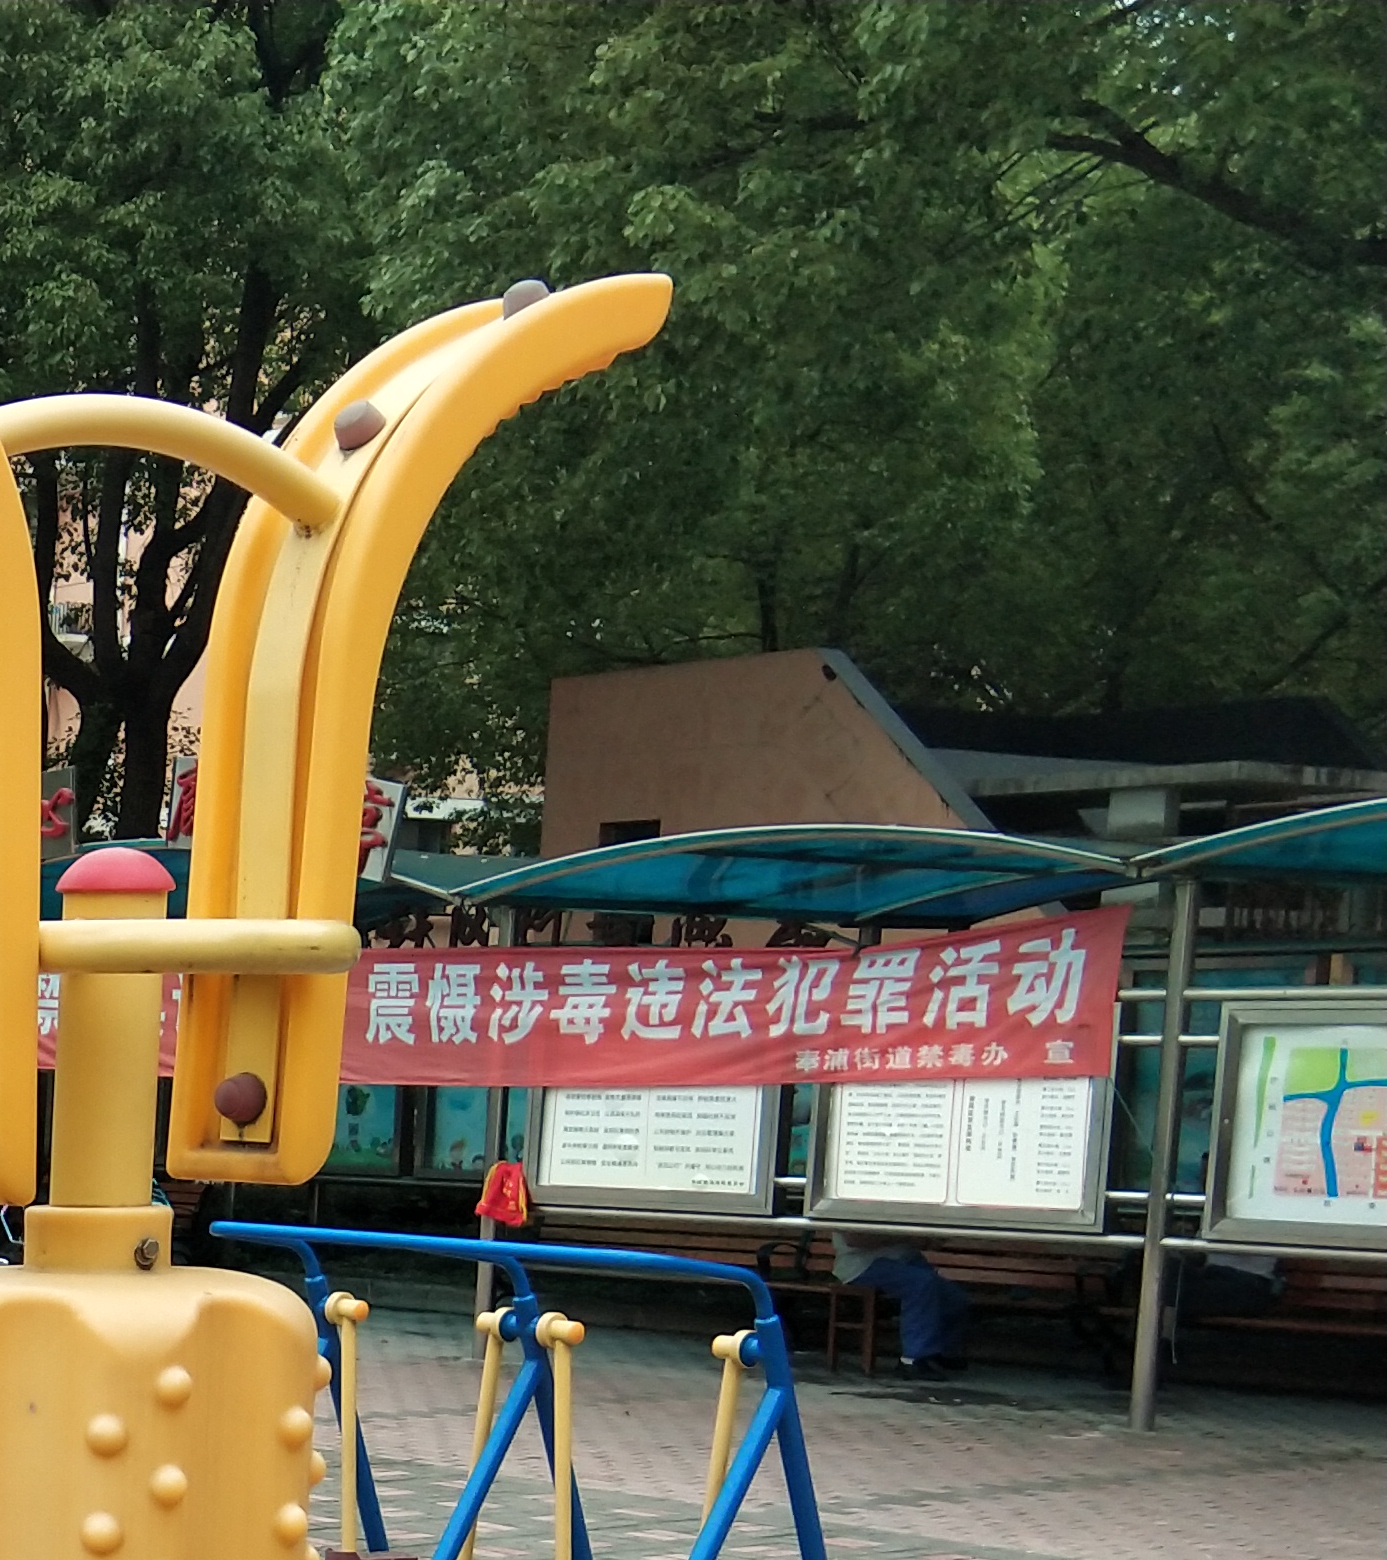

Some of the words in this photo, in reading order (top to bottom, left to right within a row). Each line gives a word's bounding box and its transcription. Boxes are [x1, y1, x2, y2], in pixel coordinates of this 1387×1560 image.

[365, 927, 1088, 1045] 震慑涉毒违法犯罪活动
[794, 1041, 1009, 1072] 奉浦街道禁毒办
[1043, 1039, 1075, 1065] 宣
